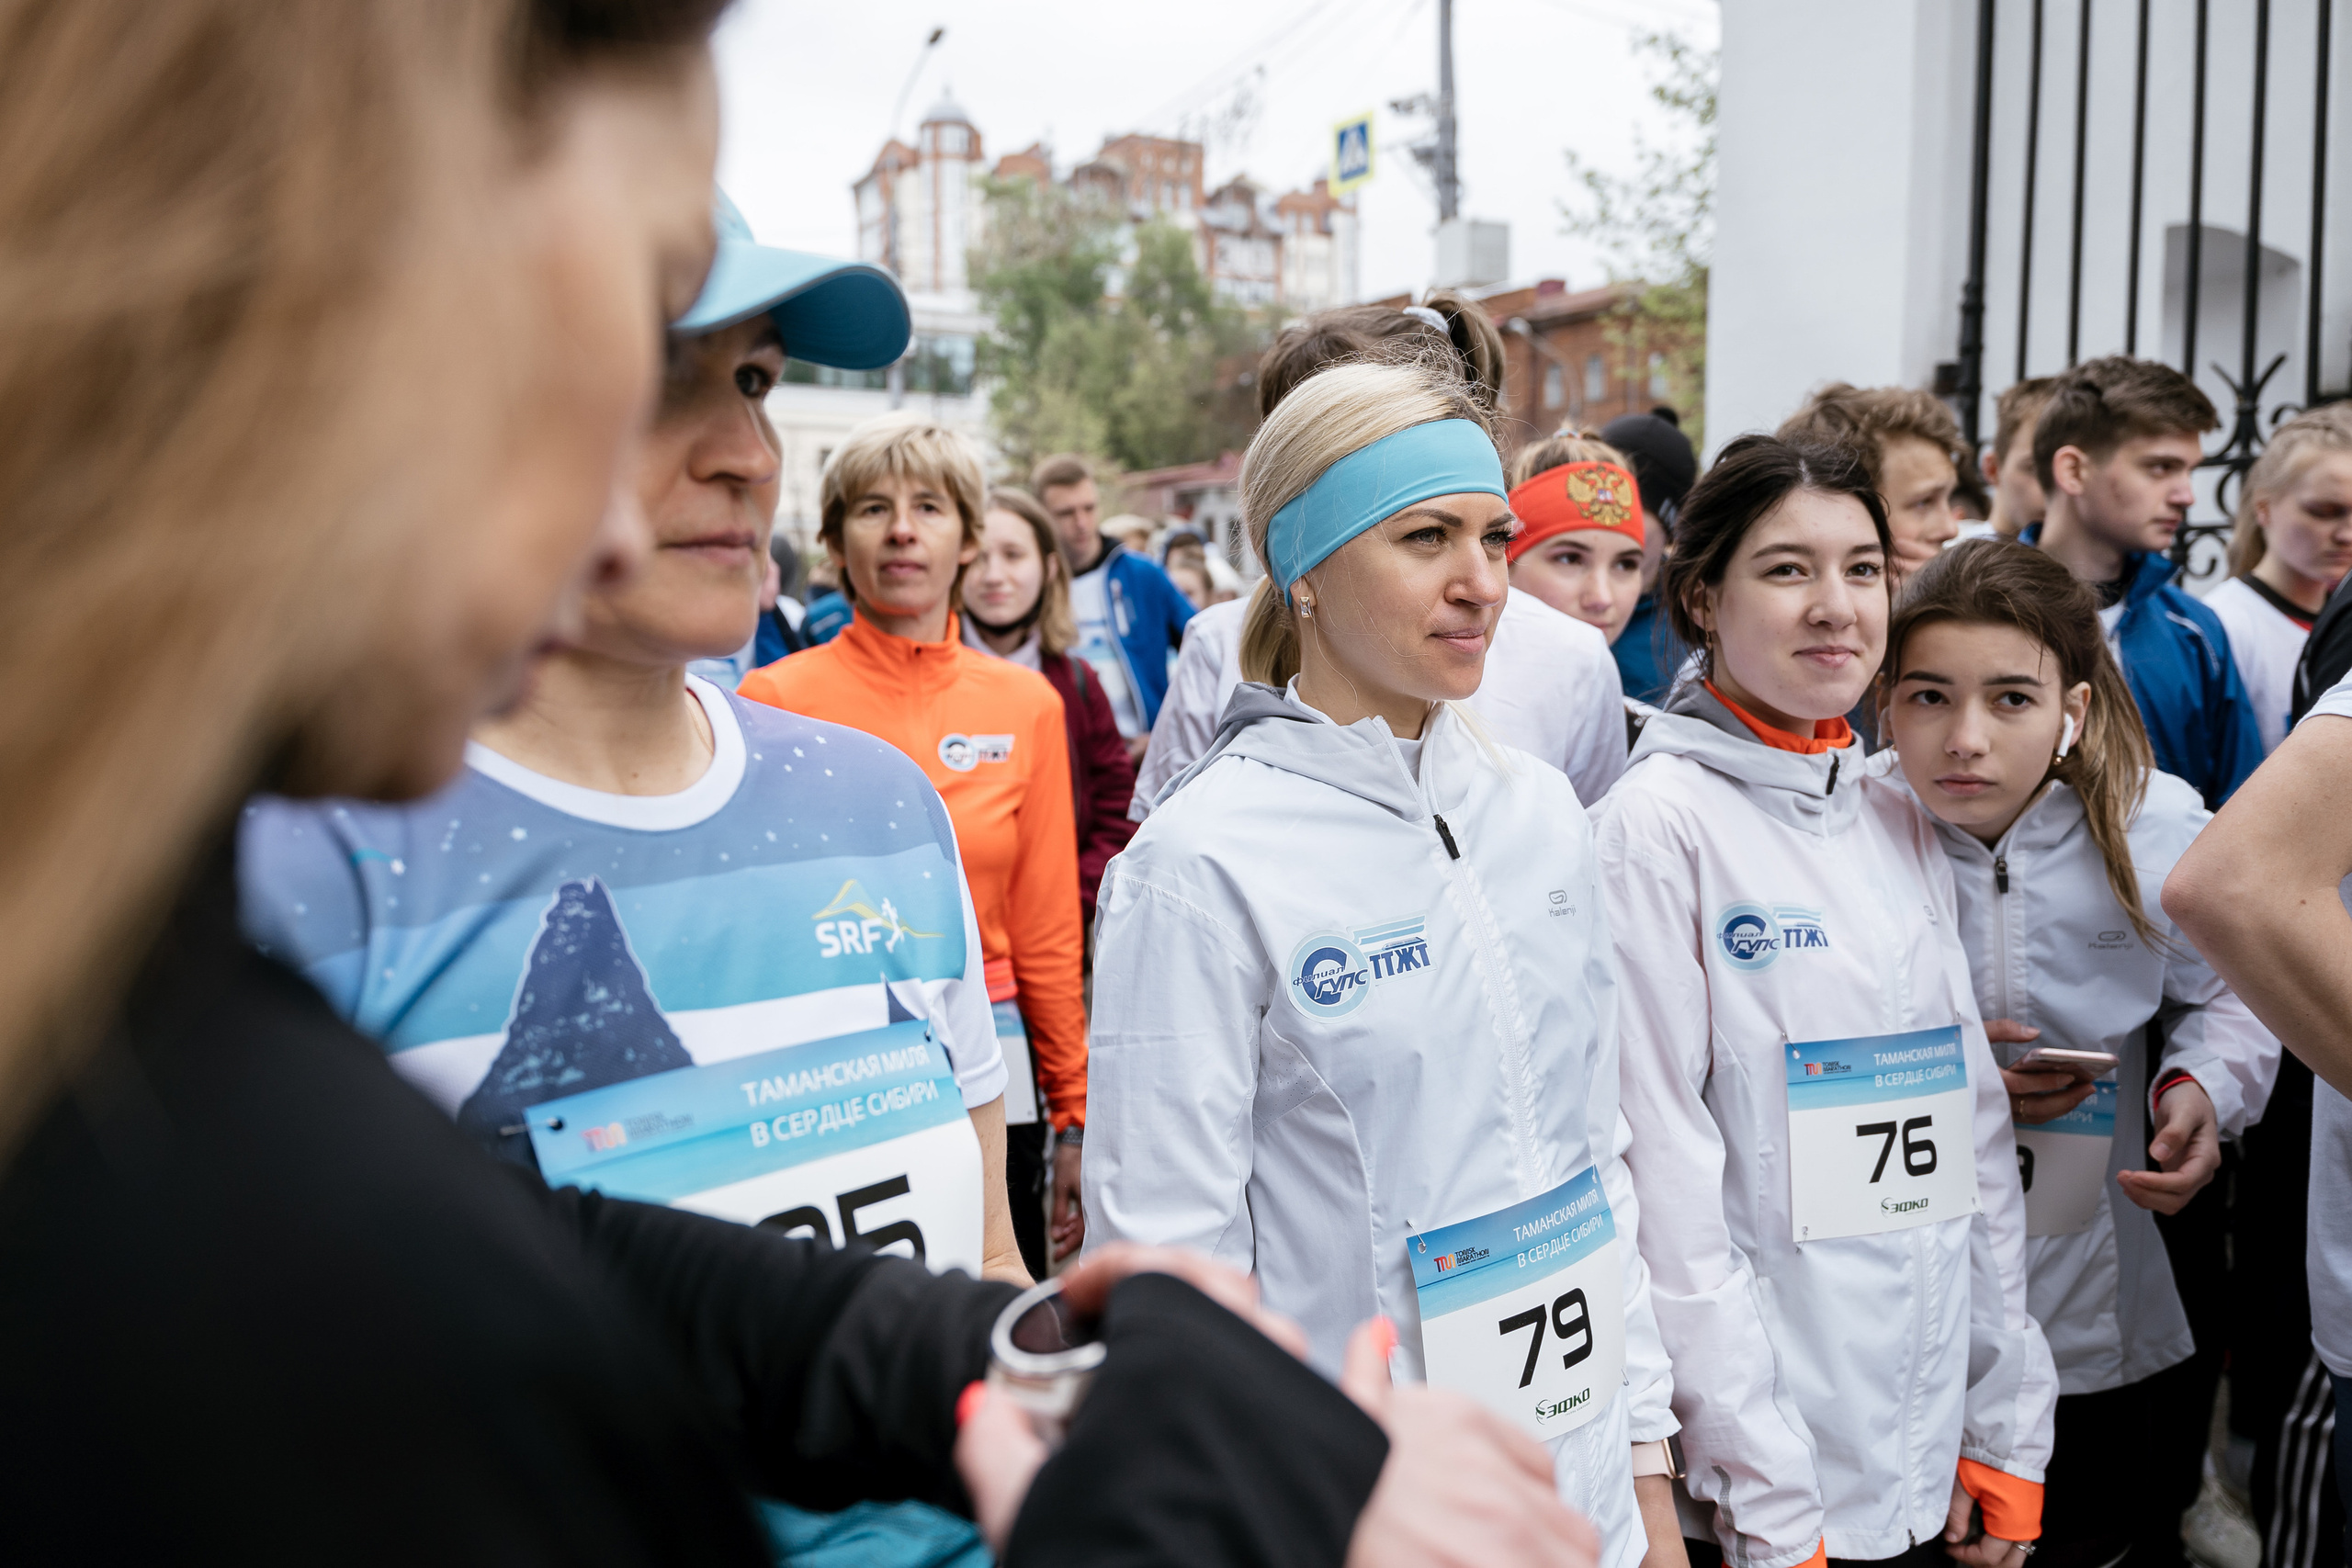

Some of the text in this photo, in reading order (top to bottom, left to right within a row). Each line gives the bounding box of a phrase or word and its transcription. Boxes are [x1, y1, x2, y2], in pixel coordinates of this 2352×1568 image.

[1548, 905, 1577, 917] Kalenji
[815, 917, 883, 958] SRF
[1293, 965, 1345, 986] филиал
[1369, 943, 1431, 980] ТТЖТ
[1873, 1043, 1956, 1066] ТАМАНСКАЯ МИЛЯ
[741, 1043, 931, 1107] ТАМАНСКАЯ МИЛЯ
[1875, 1064, 1957, 1088] В СЕРДЦЕ СИБИРИ
[750, 1078, 939, 1148] В СЕРДЦЕ СИБИРИ
[1856, 1114, 1937, 1183] 76
[1512, 1189, 1599, 1243] ТАМАНСКАЯ МИЛЯ
[1890, 1198, 1928, 1213] ЭФКО
[1454, 1247, 1476, 1258] TOMSK
[1456, 1248, 1490, 1264] MARATHON
[1517, 1252, 1526, 1269] В
[1528, 1232, 1571, 1263] СЕРДЦЕ
[1571, 1213, 1604, 1243] СИБИРИ
[1498, 1288, 1593, 1389] 79
[1546, 1387, 1591, 1419] ЭФКО
